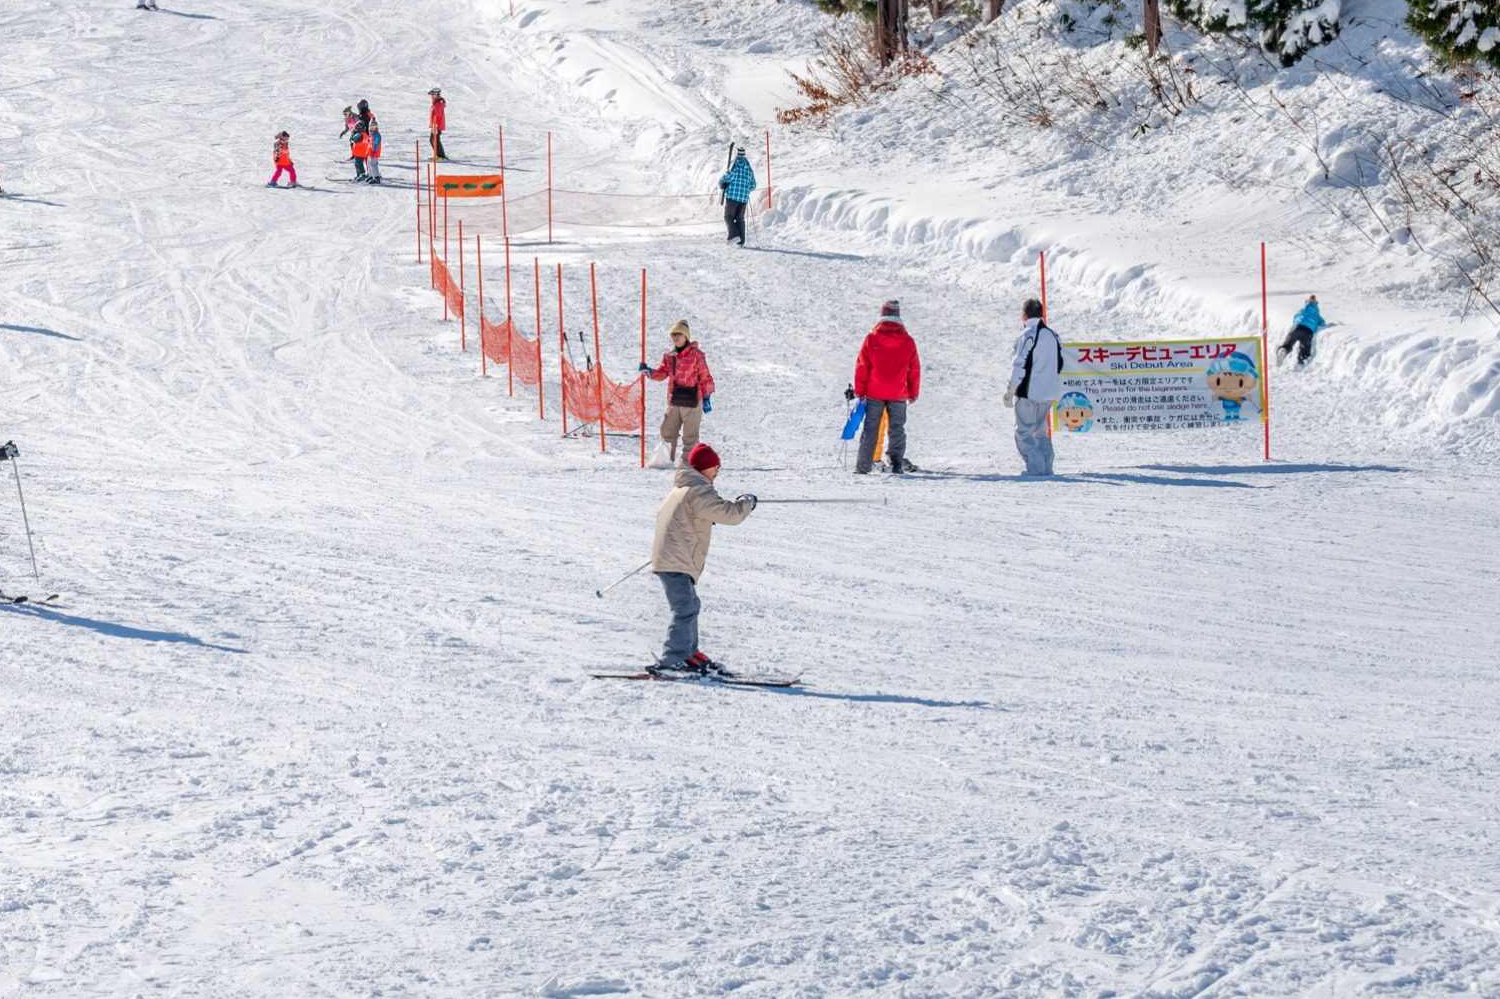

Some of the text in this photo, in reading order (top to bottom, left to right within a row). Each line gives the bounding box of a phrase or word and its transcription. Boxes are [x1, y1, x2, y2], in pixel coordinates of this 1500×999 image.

[1078, 343, 1237, 363] スキーデビューエリア
[1110, 359, 1193, 370] Ski Debut Area
